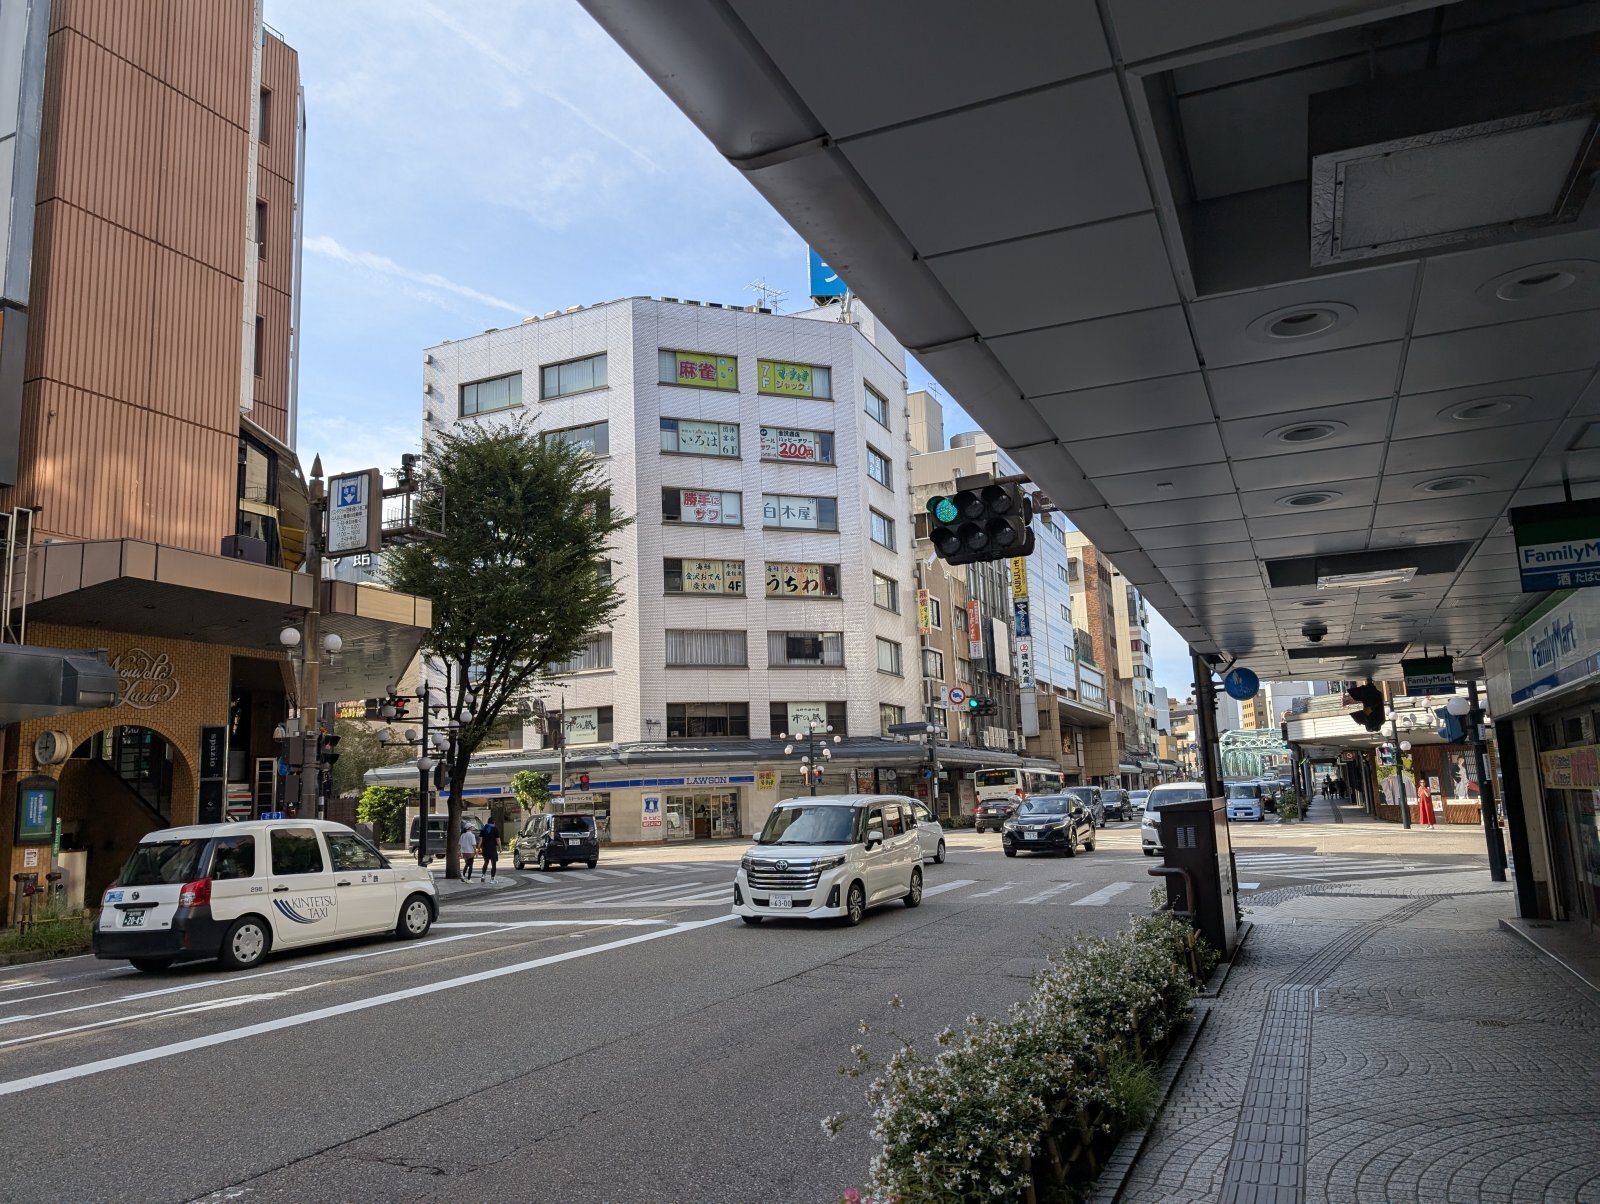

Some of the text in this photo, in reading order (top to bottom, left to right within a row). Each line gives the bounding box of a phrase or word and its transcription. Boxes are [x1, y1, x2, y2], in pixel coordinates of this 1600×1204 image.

[678, 360, 716, 381] 麻雀
[776, 380, 805, 391] ジャック
[681, 436, 718, 447] いろは
[722, 445, 738, 454] 6F
[779, 443, 814, 458] 200円
[683, 491, 720, 507] 勝手に
[694, 507, 739, 522] サワー
[763, 502, 812, 521] 白木屋
[728, 581, 742, 591] 4F
[766, 575, 819, 593] うちわ
[1557, 572, 1571, 586] 酒
[1531, 612, 1577, 670] FamilyMart
[1407, 675, 1453, 684] FamilyMart
[209, 733, 217, 767] spazio
[686, 776, 728, 785] LAWSON
[291, 895, 337, 909] KINTETSU
[308, 907, 329, 919] TAXI
